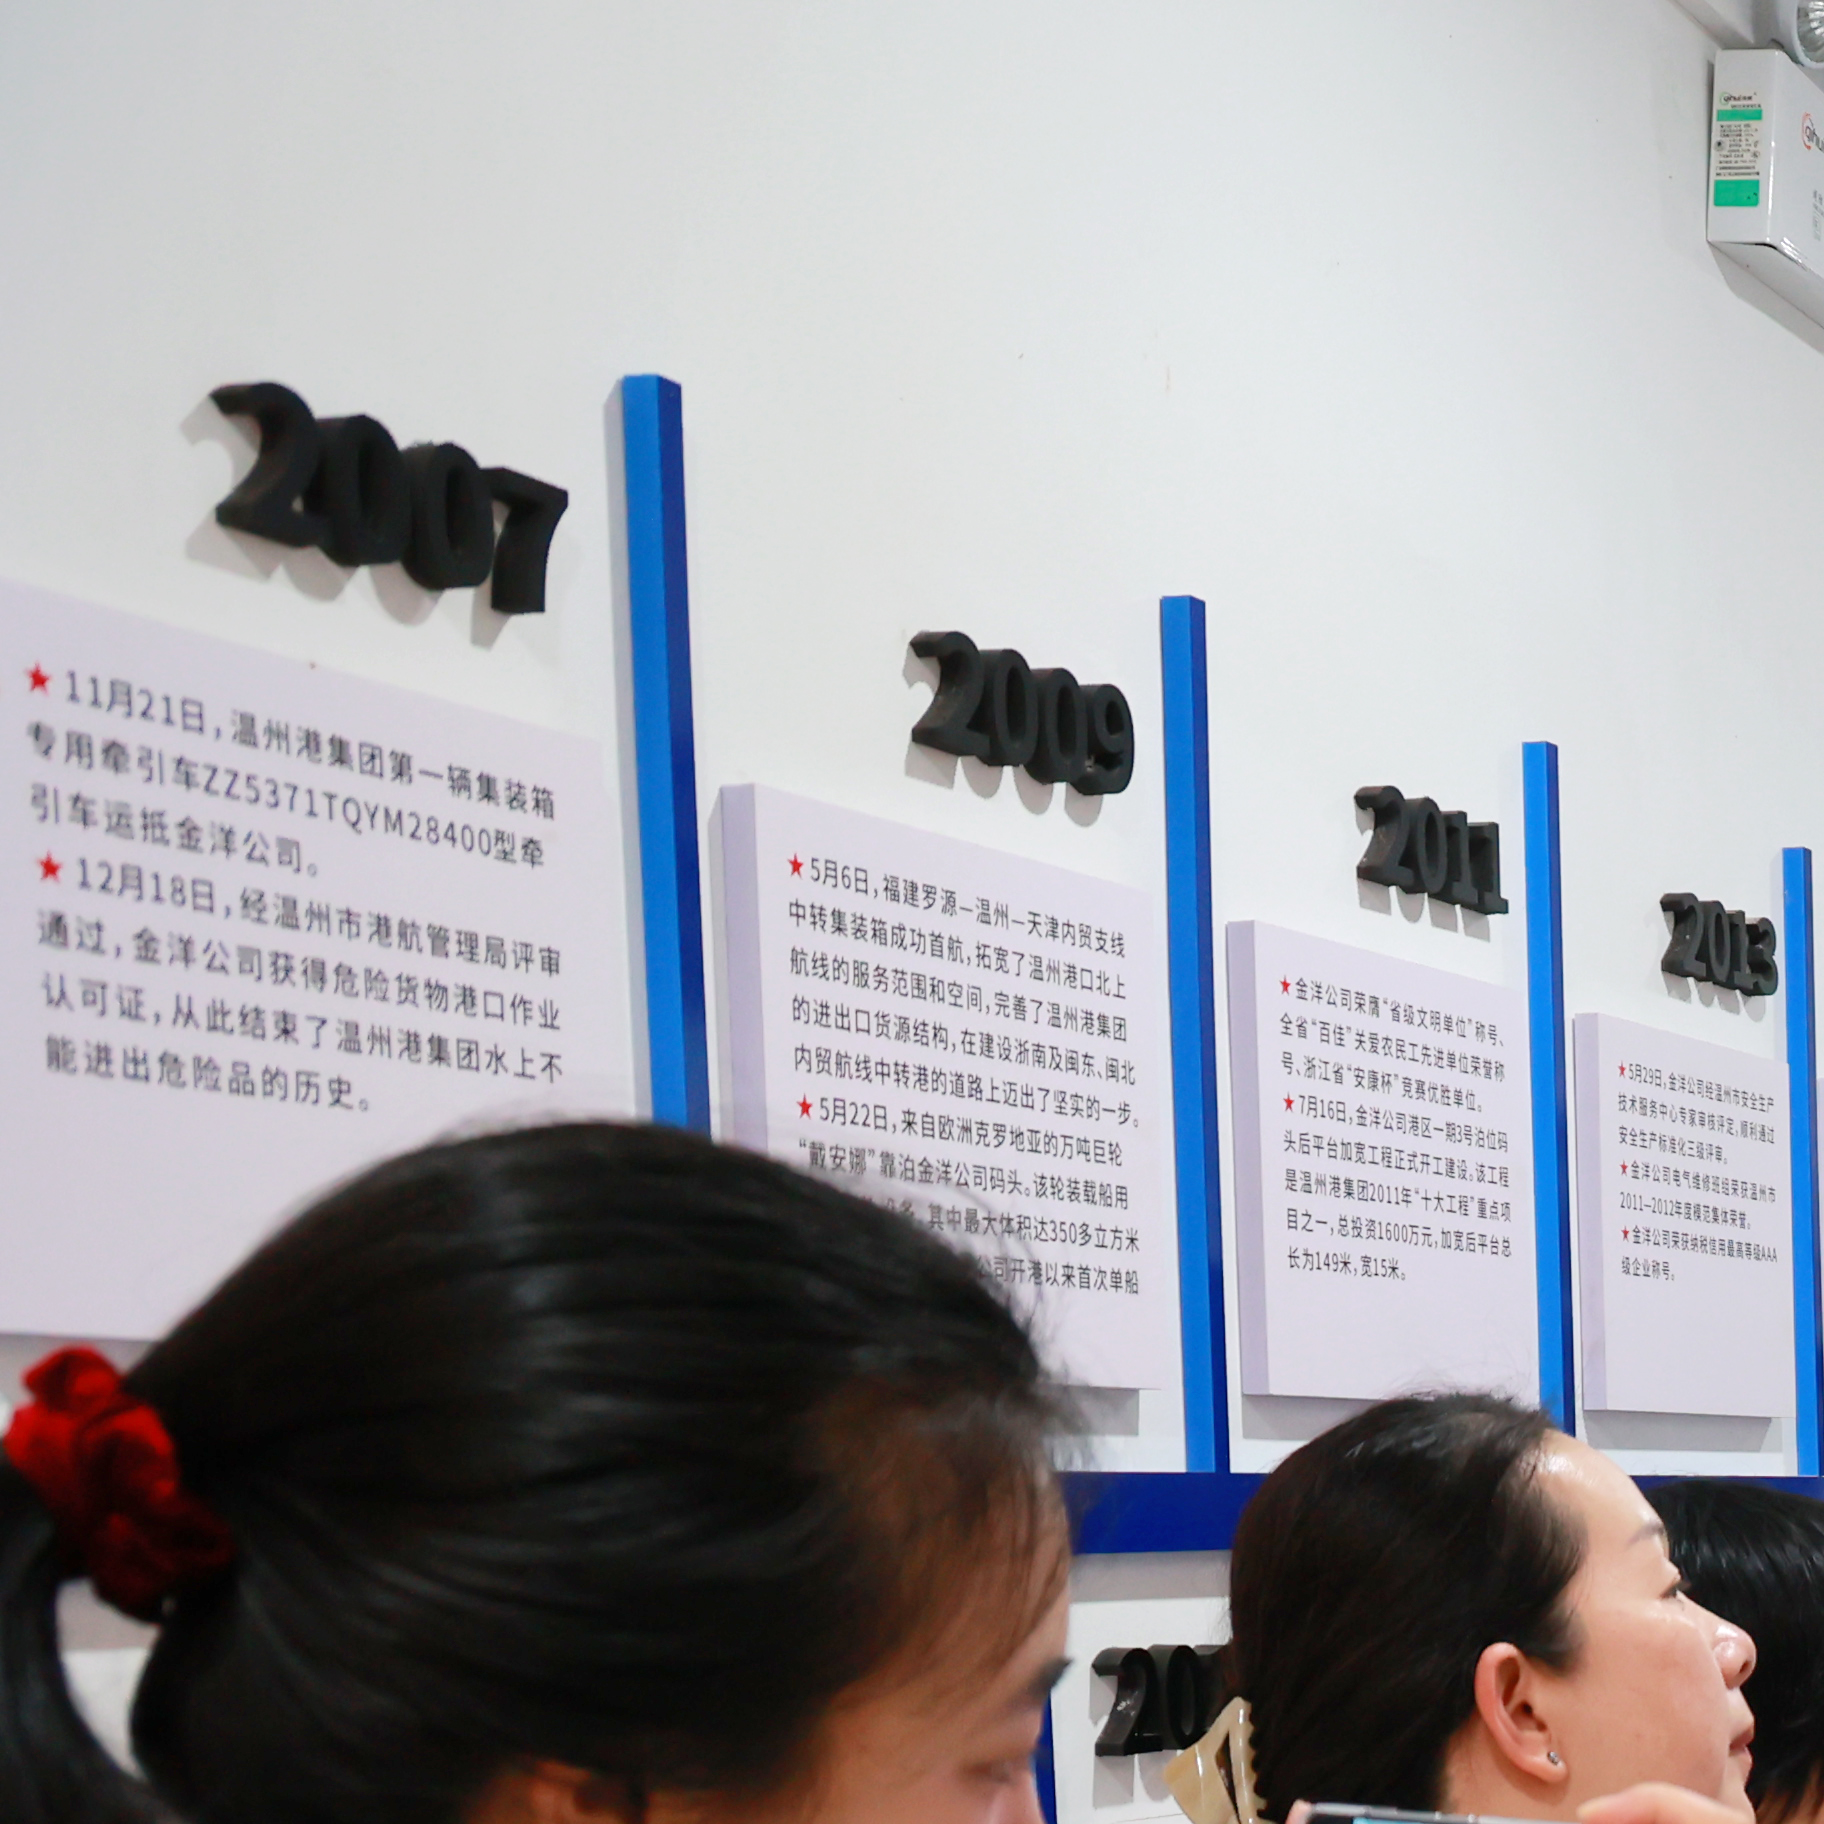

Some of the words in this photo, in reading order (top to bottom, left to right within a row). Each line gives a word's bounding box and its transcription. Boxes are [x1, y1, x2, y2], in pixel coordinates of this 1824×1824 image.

[210, 382, 569, 614] 2007
[64, 670, 555, 820] 11月21日，温州港集团第一辆集装箱
[911, 630, 1134, 795] 2009
[27, 721, 544, 869] 专用牵引车ZZ5371TQYM28400型牵
[31, 784, 318, 878] 引车运抵金洋公司。
[1354, 786, 1508, 915] 2011
[78, 858, 561, 976] 12月18日，经温州市港航管理局评审
[789, 900, 1126, 1000] 中转集装箱成功首航，拓宽了温州港口北上
[1660, 893, 1778, 996] 2013
[38, 910, 560, 1030] 通过，金洋公司获得危险货物港口作业
[790, 946, 1127, 1042] 航线的服务范围和空间，完善了温州港集团
[42, 972, 562, 1084] 认可证，从此结束了温州港集团水上不
[47, 1035, 368, 1112] 能进出危险品的历史。
[792, 996, 1135, 1085] 的进出口货源结构，在建设浙南及闽东、闽北
[1280, 1013, 1505, 1083] 全省“百佳”关爱农民工先进单位荣誉称
[794, 1044, 1139, 1128] 内贸航线中转港的道路上迈出了坚实的一步。
[1281, 1051, 1482, 1113] 号、浙江省“安康杯”竞赛优胜单位。
[1299, 1095, 1508, 1153] 7月16日，金洋公司港区一期3号泊位码
[820, 1097, 1123, 1166] 5月22日，来自欧洲克罗地亚的万吨巨轮
[1284, 1130, 1510, 1188] 头后平台加宽工程正式开工建设。该工程
[1285, 1168, 1511, 1222] 是温州港集团2011年“十大工程”重点项
[1286, 1207, 1512, 1257] 目之一，总投资1600万元，加宽后平台总
[1287, 1245, 1406, 1281] 长为149米，宽15米。
